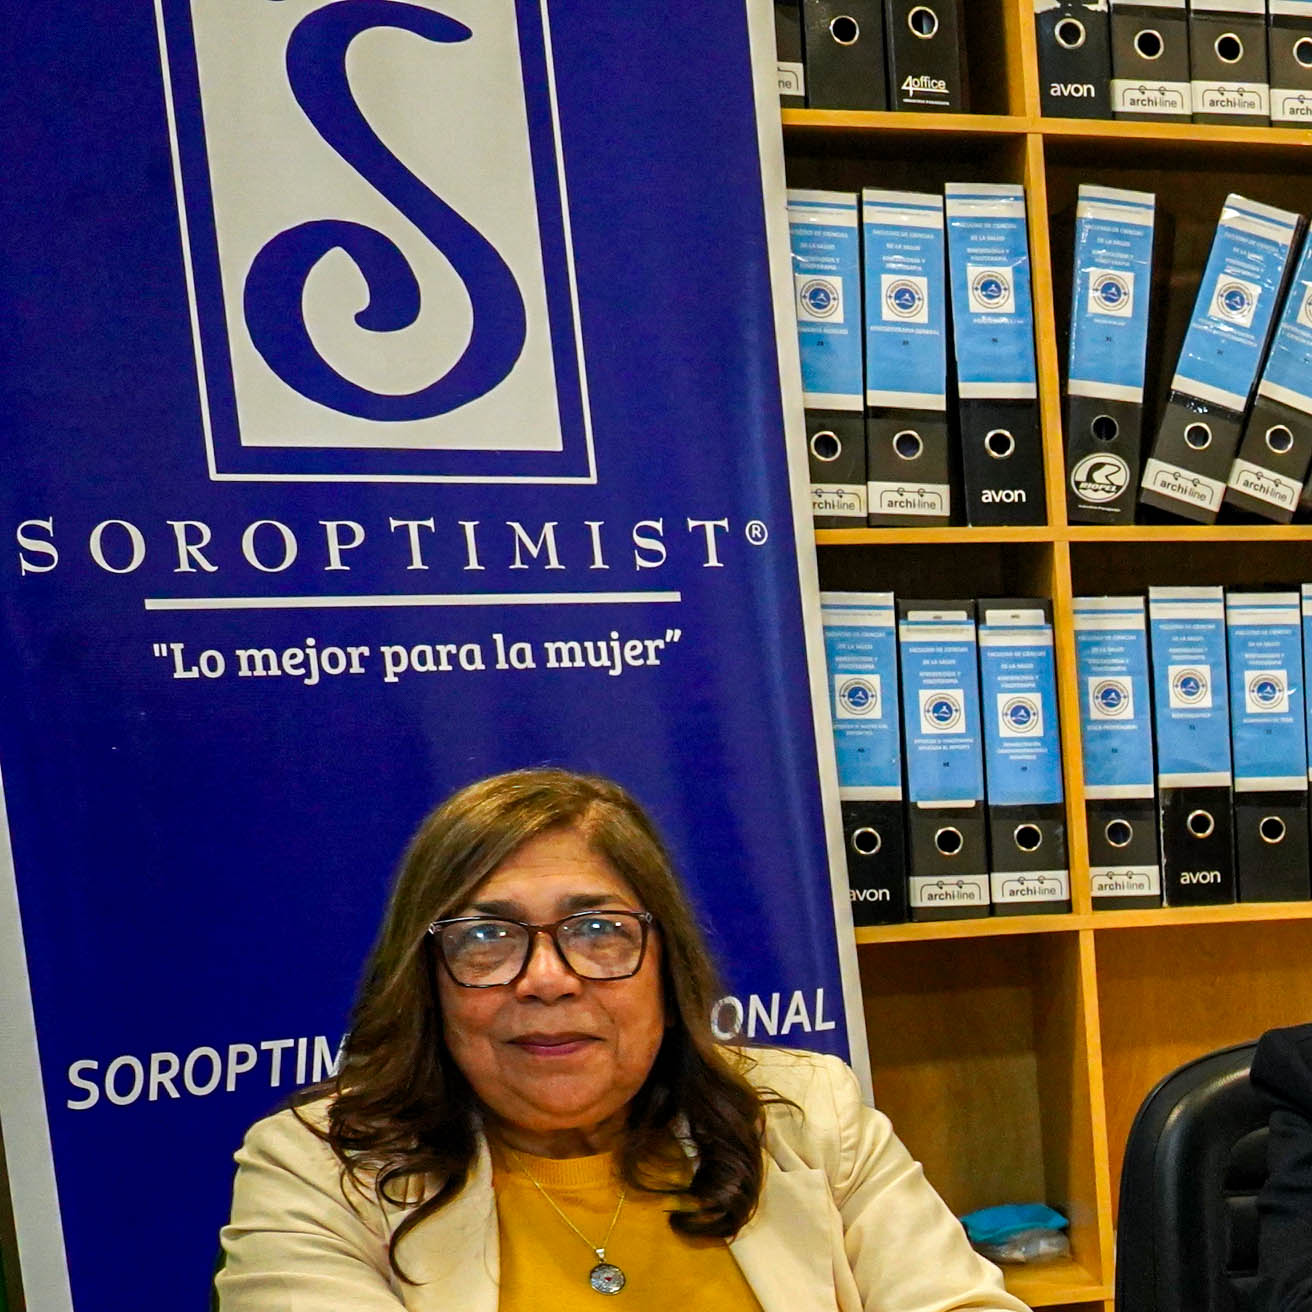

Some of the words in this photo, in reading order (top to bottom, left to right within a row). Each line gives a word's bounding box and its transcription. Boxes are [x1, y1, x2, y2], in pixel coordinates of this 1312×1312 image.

[1050, 83, 1096, 98] avon
[981, 489, 1026, 503] avon
[235, 637, 370, 686] mejor
[380, 643, 486, 683] para
[492, 633, 537, 670] la
[1180, 870, 1221, 885] avon
[849, 888, 890, 903] avon
[66, 1034, 349, 1111] SOROPTIM
